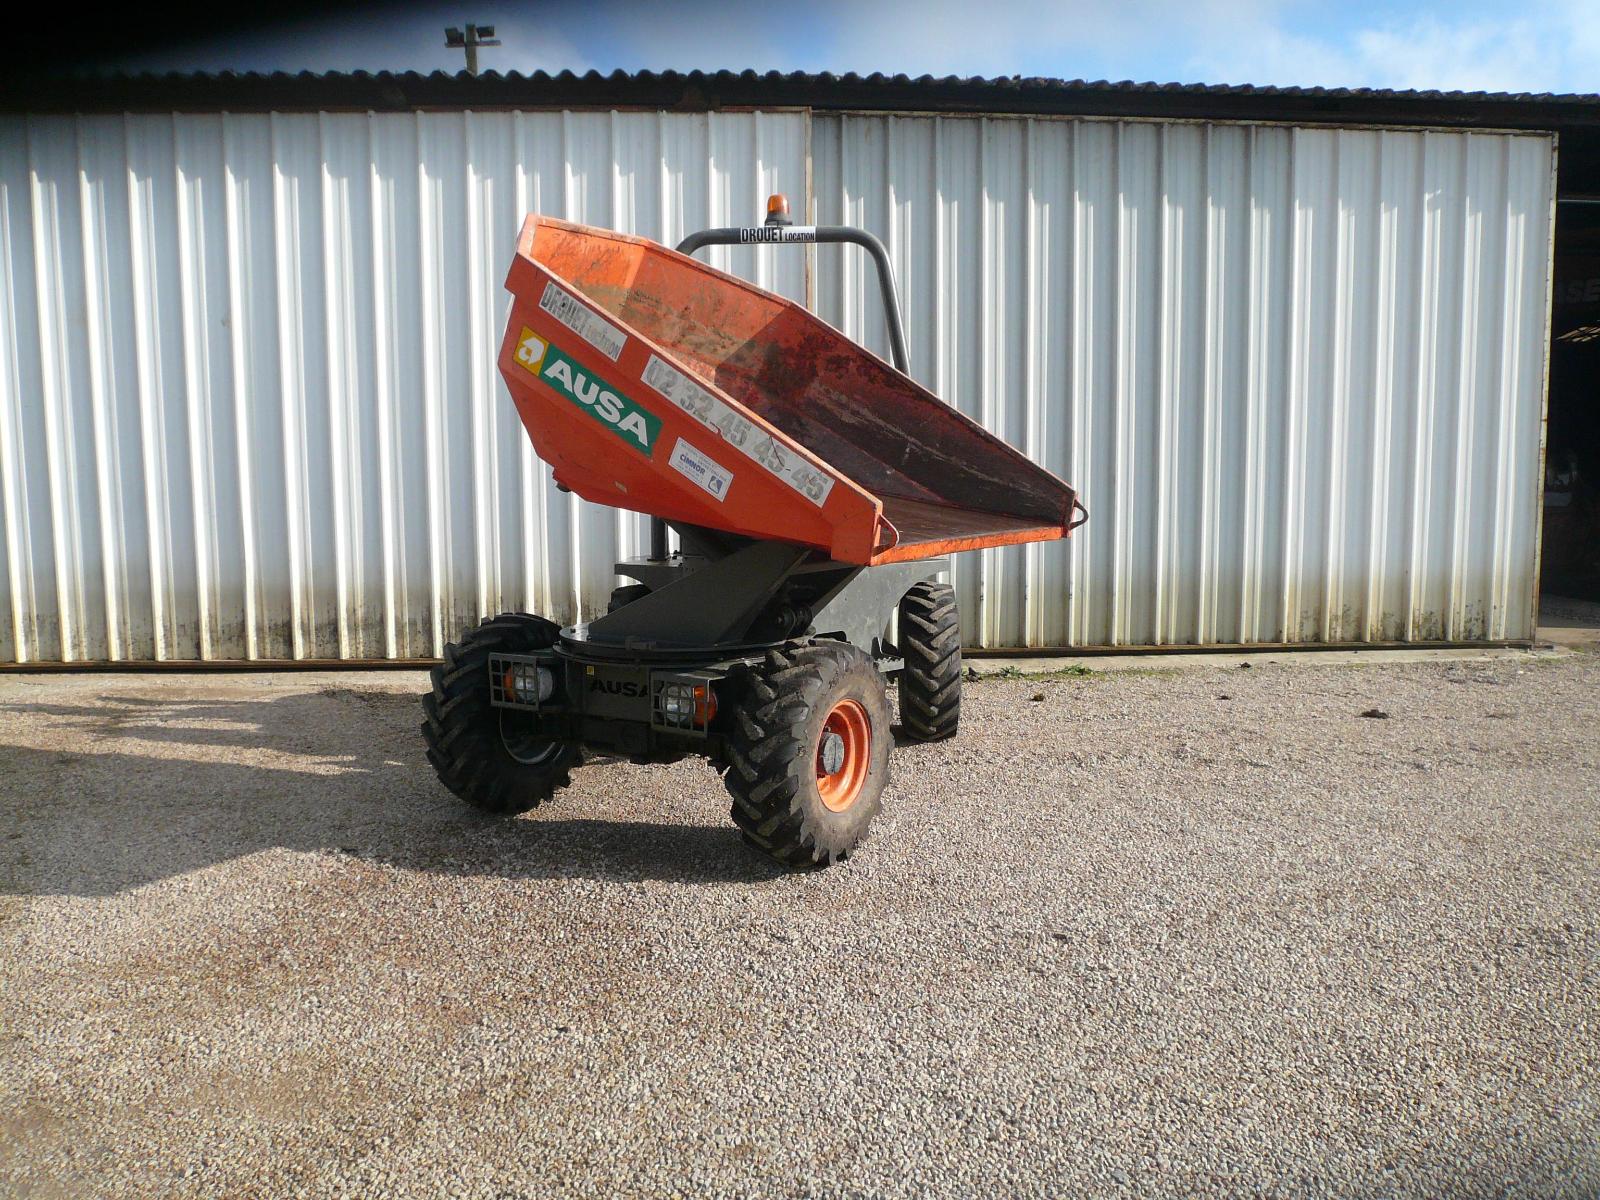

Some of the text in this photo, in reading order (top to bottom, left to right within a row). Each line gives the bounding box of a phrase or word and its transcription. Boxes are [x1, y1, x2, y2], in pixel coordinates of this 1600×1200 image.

[742, 227, 814, 242] DROUET LOCATION
[544, 359, 648, 447] AUSA
[646, 360, 678, 397] 02
[680, 380, 714, 422] 32
[717, 412, 751, 446] 45
[753, 439, 789, 472] 45
[791, 469, 829, 500] 45
